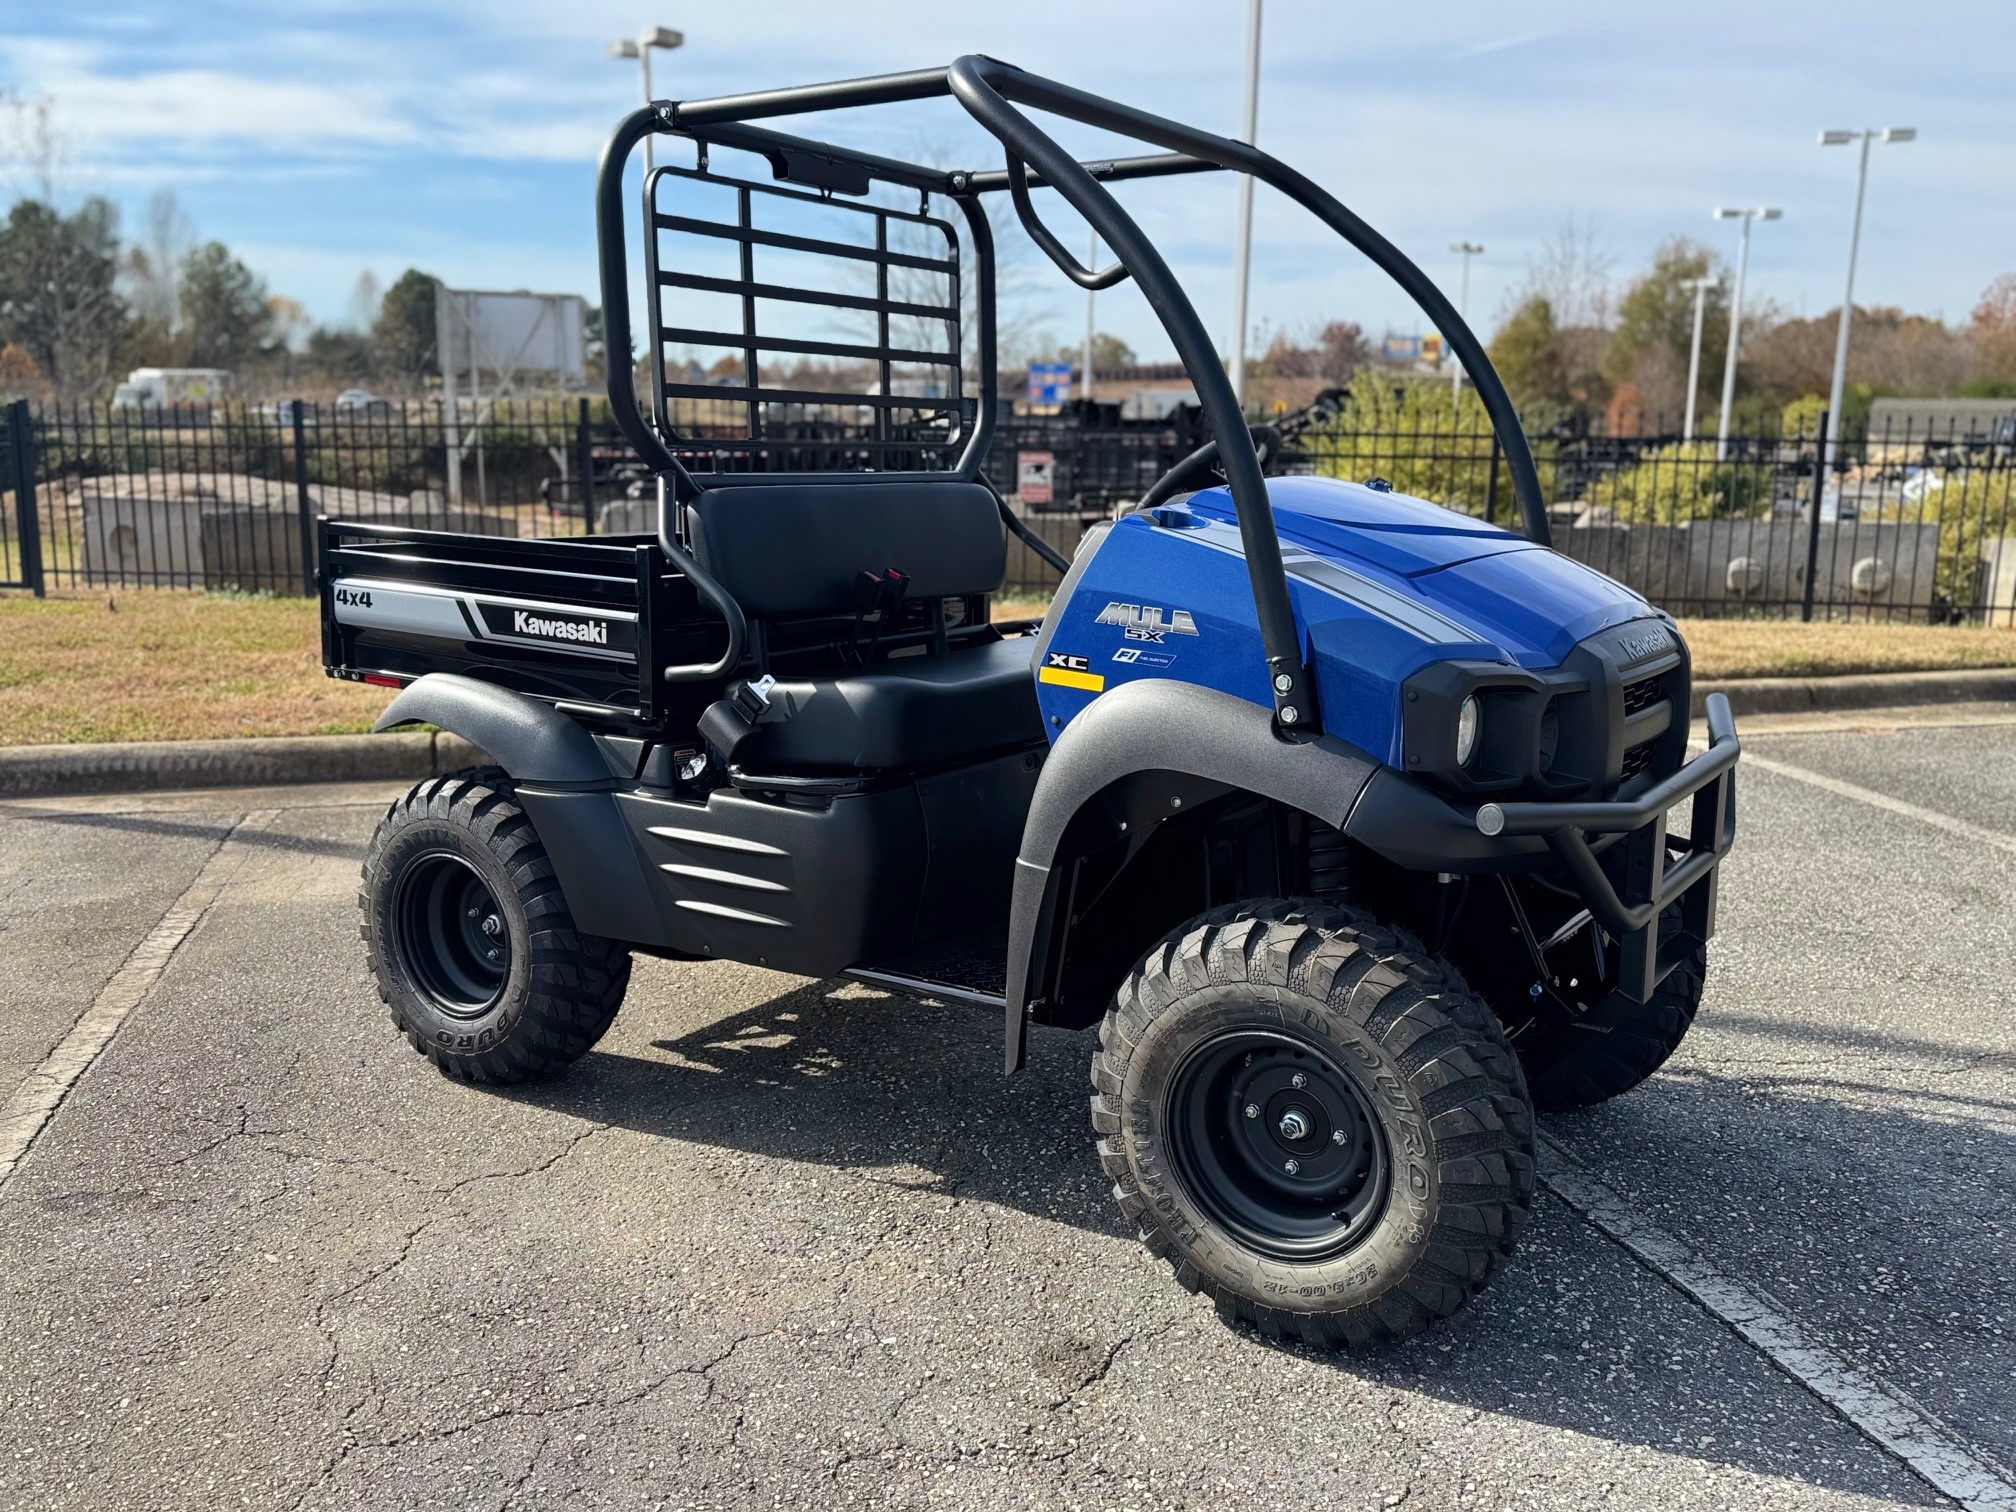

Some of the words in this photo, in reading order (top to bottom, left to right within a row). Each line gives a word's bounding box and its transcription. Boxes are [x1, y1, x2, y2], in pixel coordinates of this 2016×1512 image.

[336, 588, 373, 609] 4x4
[514, 611, 607, 645] Kawasaki
[1095, 601, 1200, 637] MULE
[1124, 628, 1165, 644] SX
[1049, 653, 1088, 671] XC
[1116, 650, 1137, 661] FI
[436, 1008, 511, 1049] DURO
[1338, 1036, 1430, 1202] DURO
